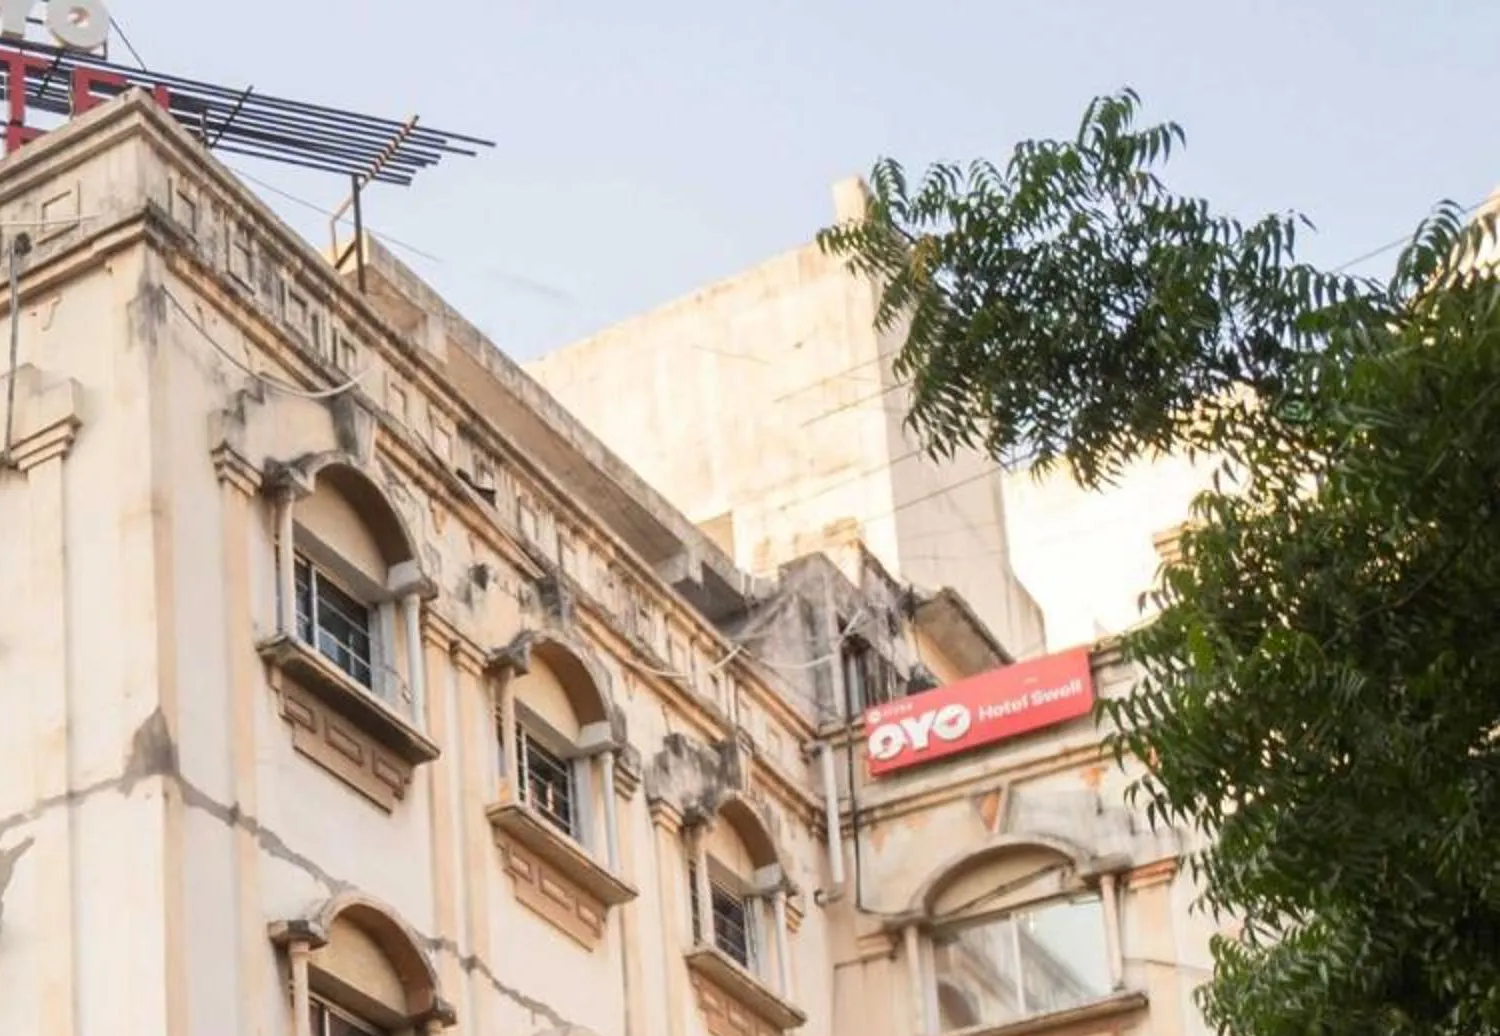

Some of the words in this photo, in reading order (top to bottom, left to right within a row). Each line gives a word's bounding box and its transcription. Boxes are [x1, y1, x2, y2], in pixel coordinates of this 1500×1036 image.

[978, 696, 1028, 721] Hotel
[1031, 679, 1082, 707] Swell
[868, 704, 971, 760] OYO
